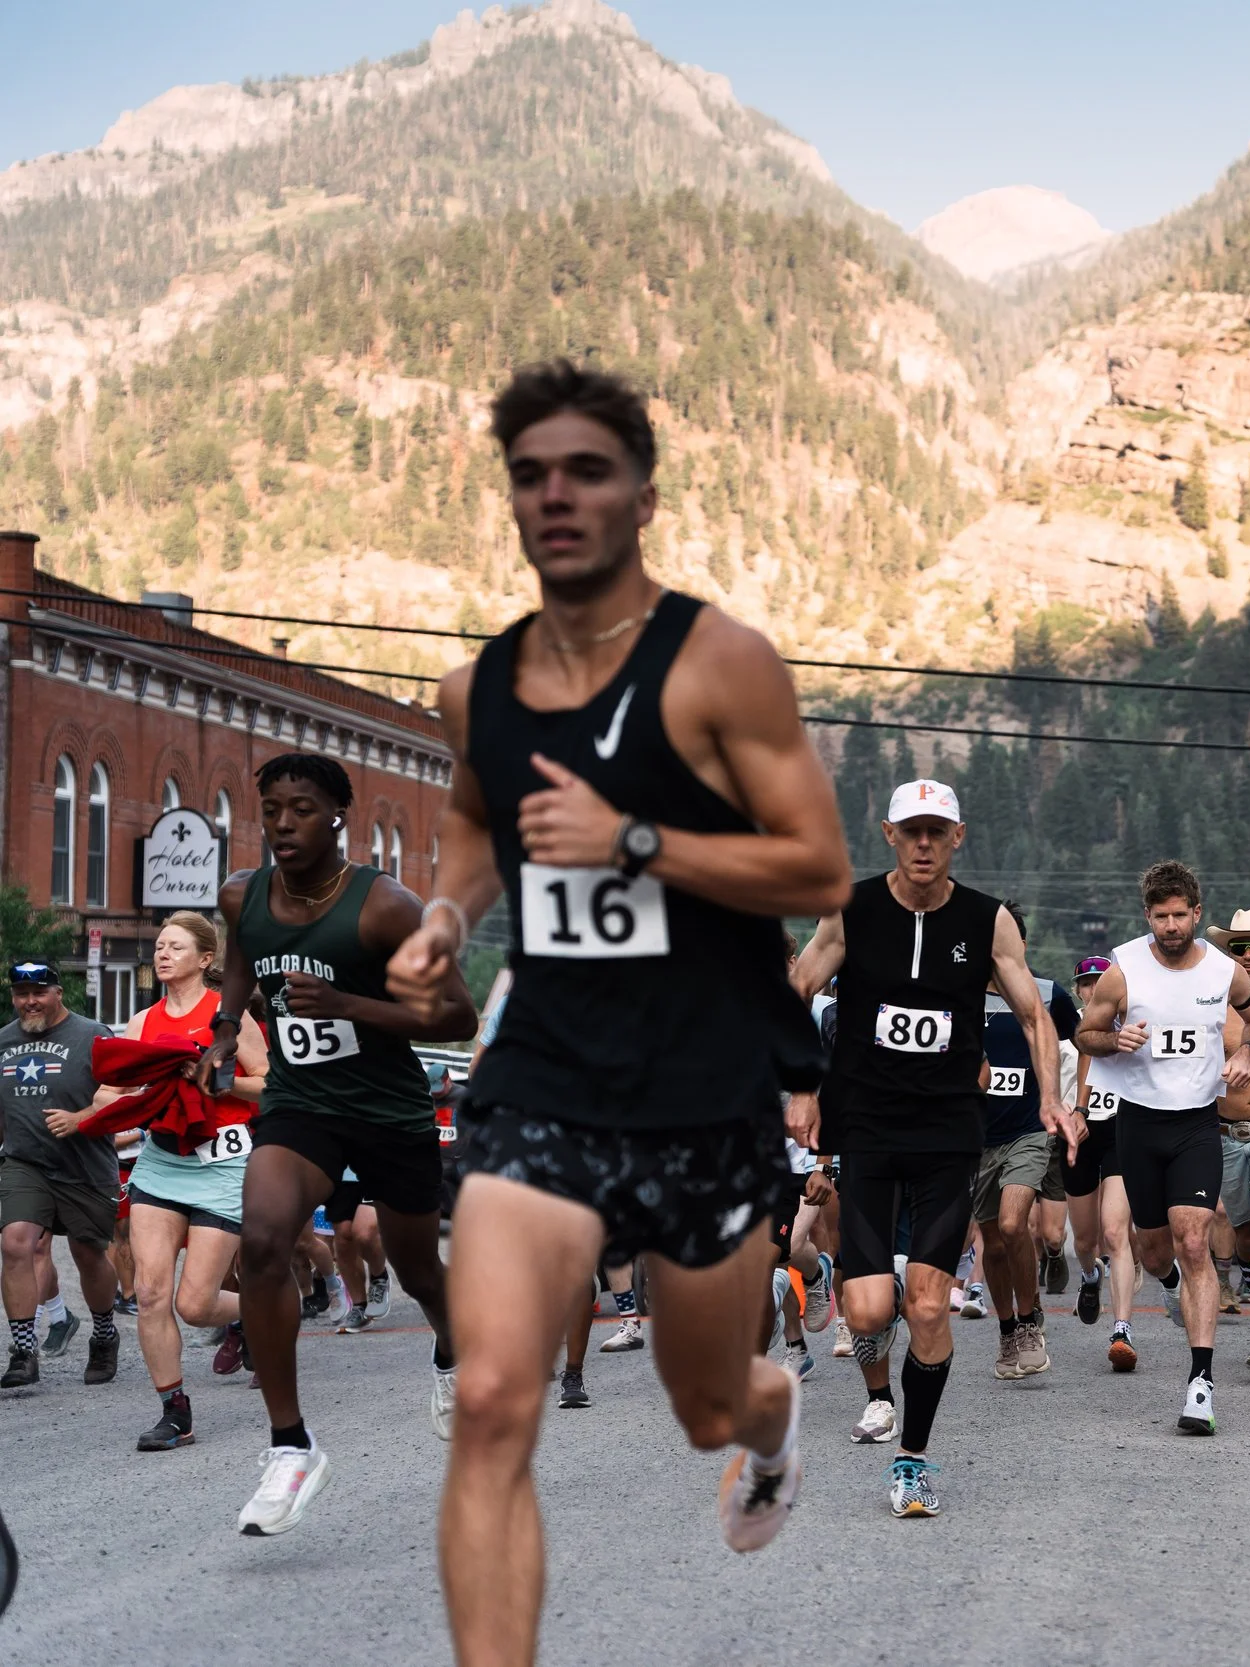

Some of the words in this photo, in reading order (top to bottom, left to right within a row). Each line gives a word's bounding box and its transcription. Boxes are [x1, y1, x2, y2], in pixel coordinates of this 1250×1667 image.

[148, 844, 214, 870] Hotel
[149, 873, 211, 900] Ouray
[545, 878, 636, 945] 16
[254, 954, 334, 982] COLORADO
[287, 1020, 341, 1060] 95
[888, 1013, 938, 1048] 80
[1161, 1029, 1196, 1055] 15
[2, 1041, 70, 1062] AMERICA
[13, 1085, 47, 1097] 1776
[989, 1073, 1020, 1091] 29
[1090, 1092, 1115, 1109] 26
